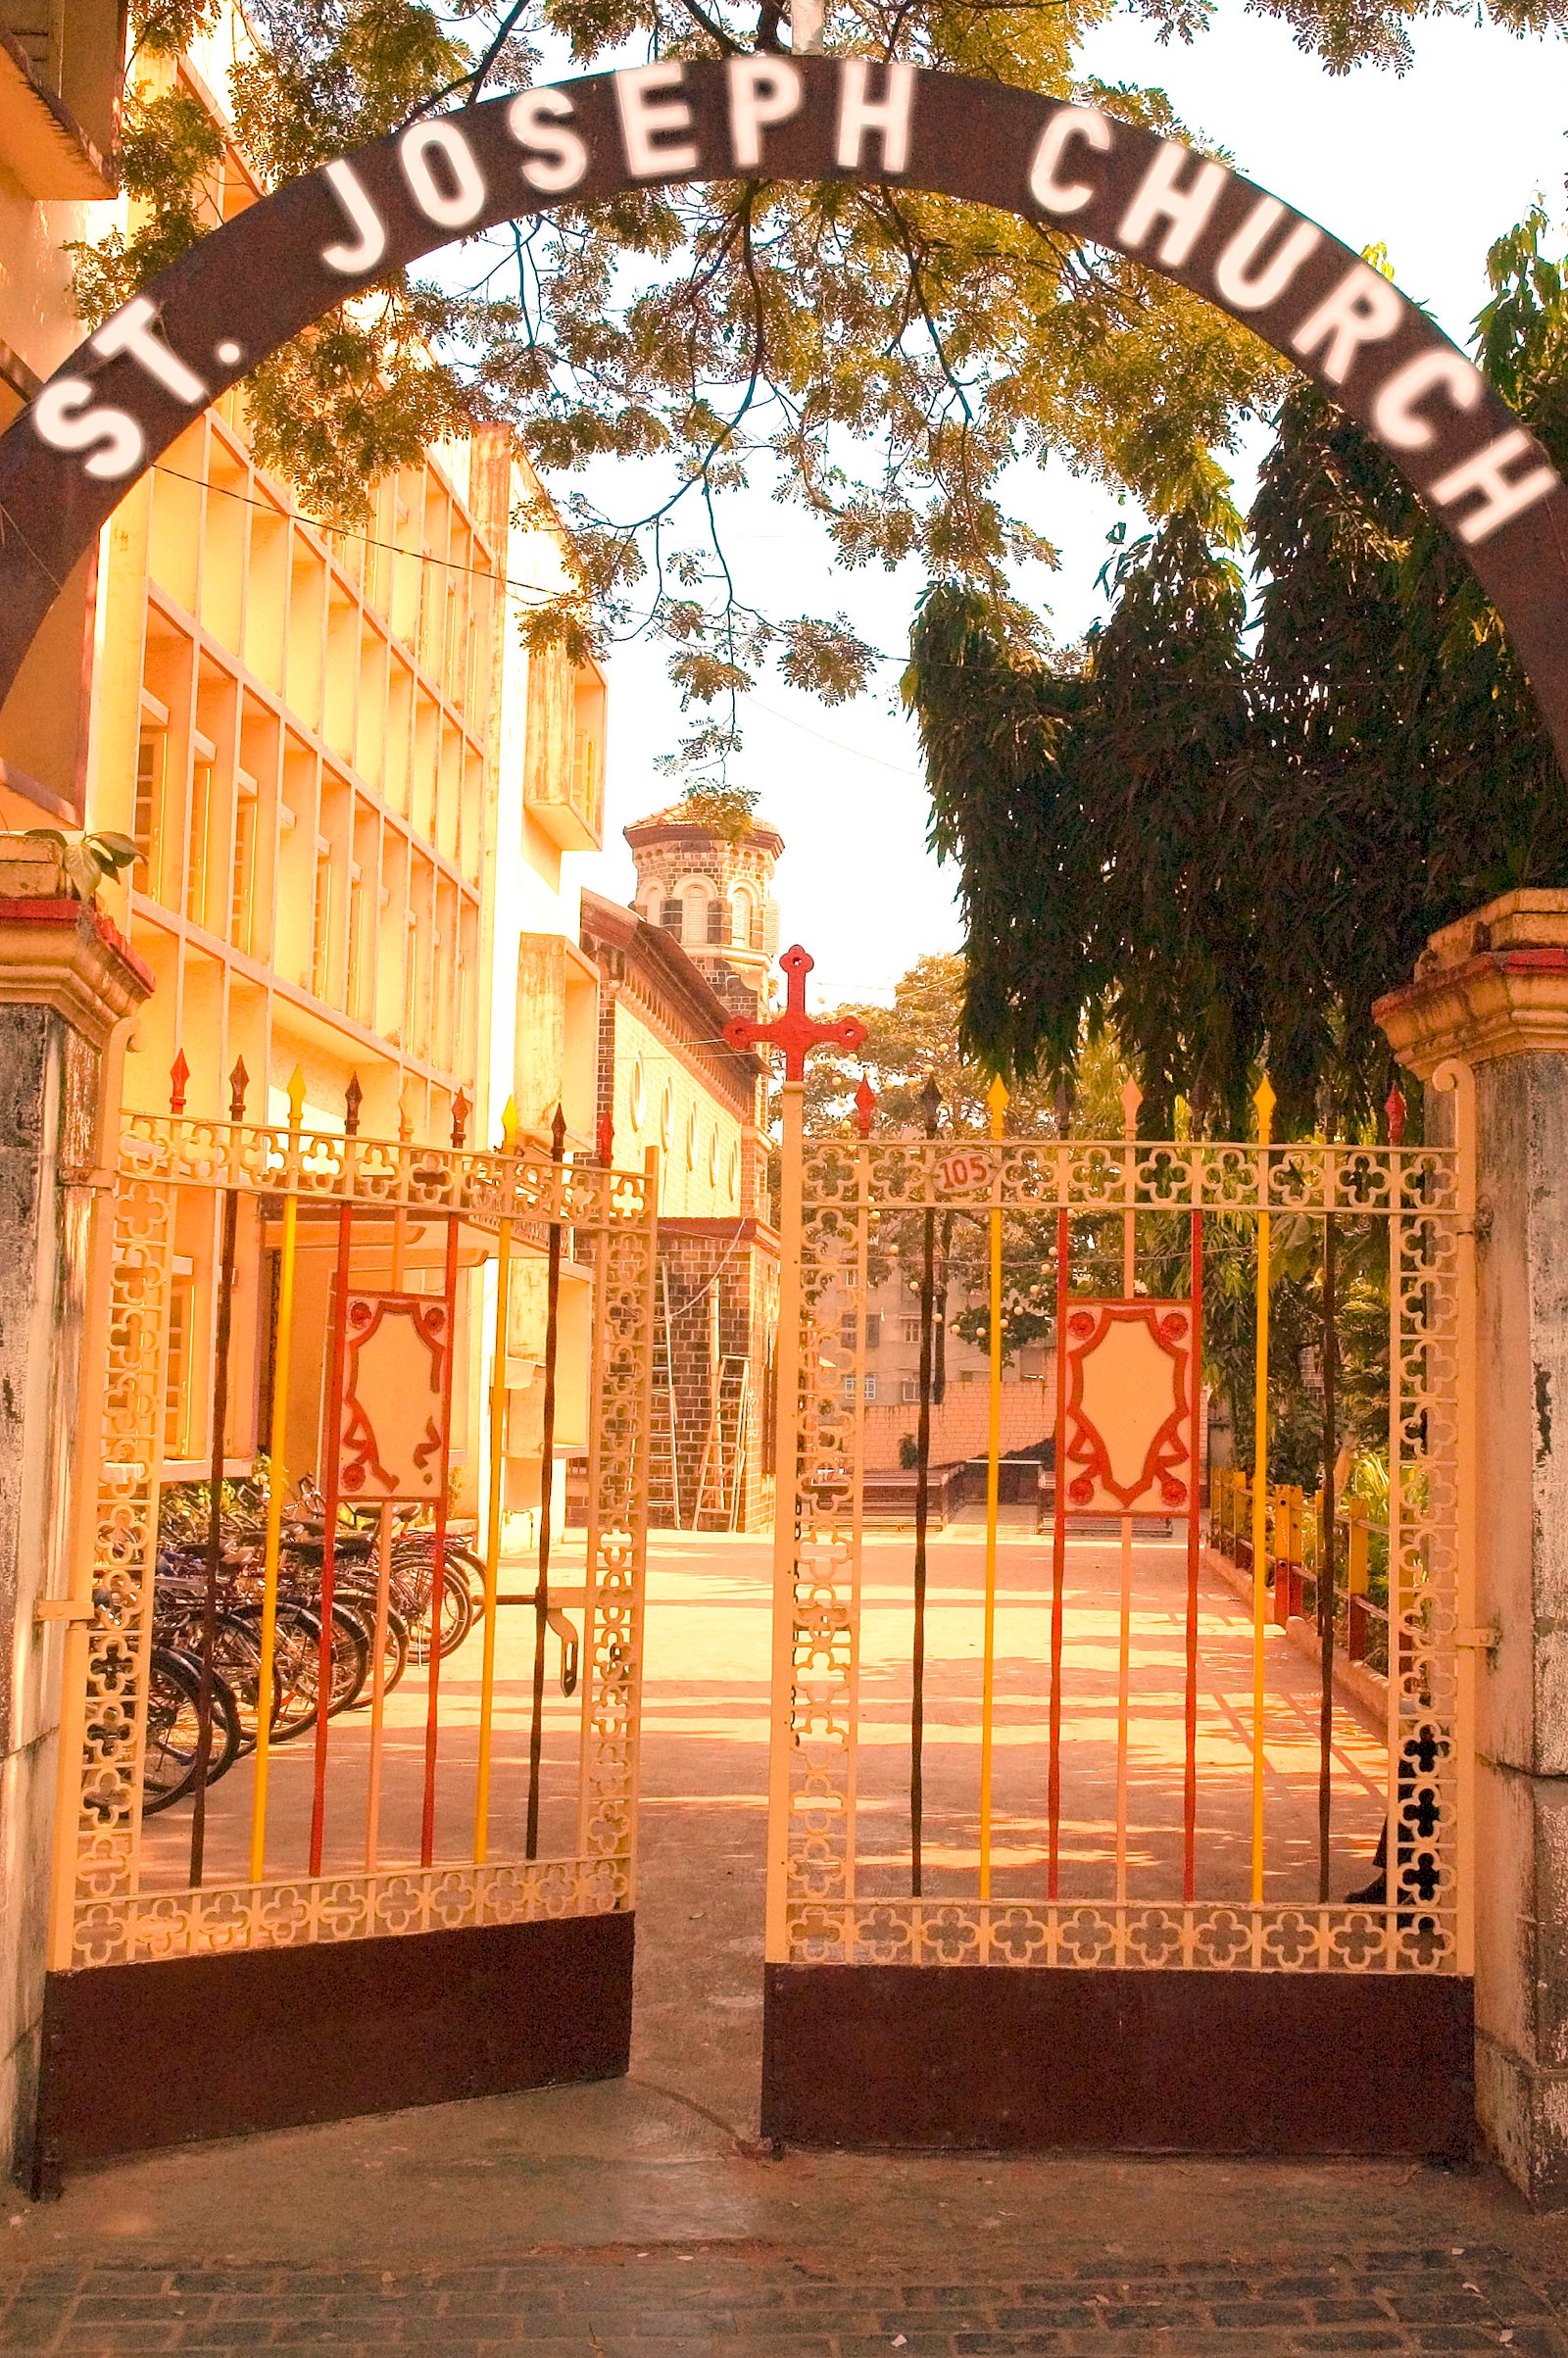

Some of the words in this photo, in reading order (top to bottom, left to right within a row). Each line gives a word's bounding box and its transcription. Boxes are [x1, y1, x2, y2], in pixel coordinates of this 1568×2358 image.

[34, 299, 242, 477] ST.
[321, 56, 916, 274] JOSEPH
[1030, 107, 1555, 543] CHURCH
[940, 1156, 988, 1189] 105
